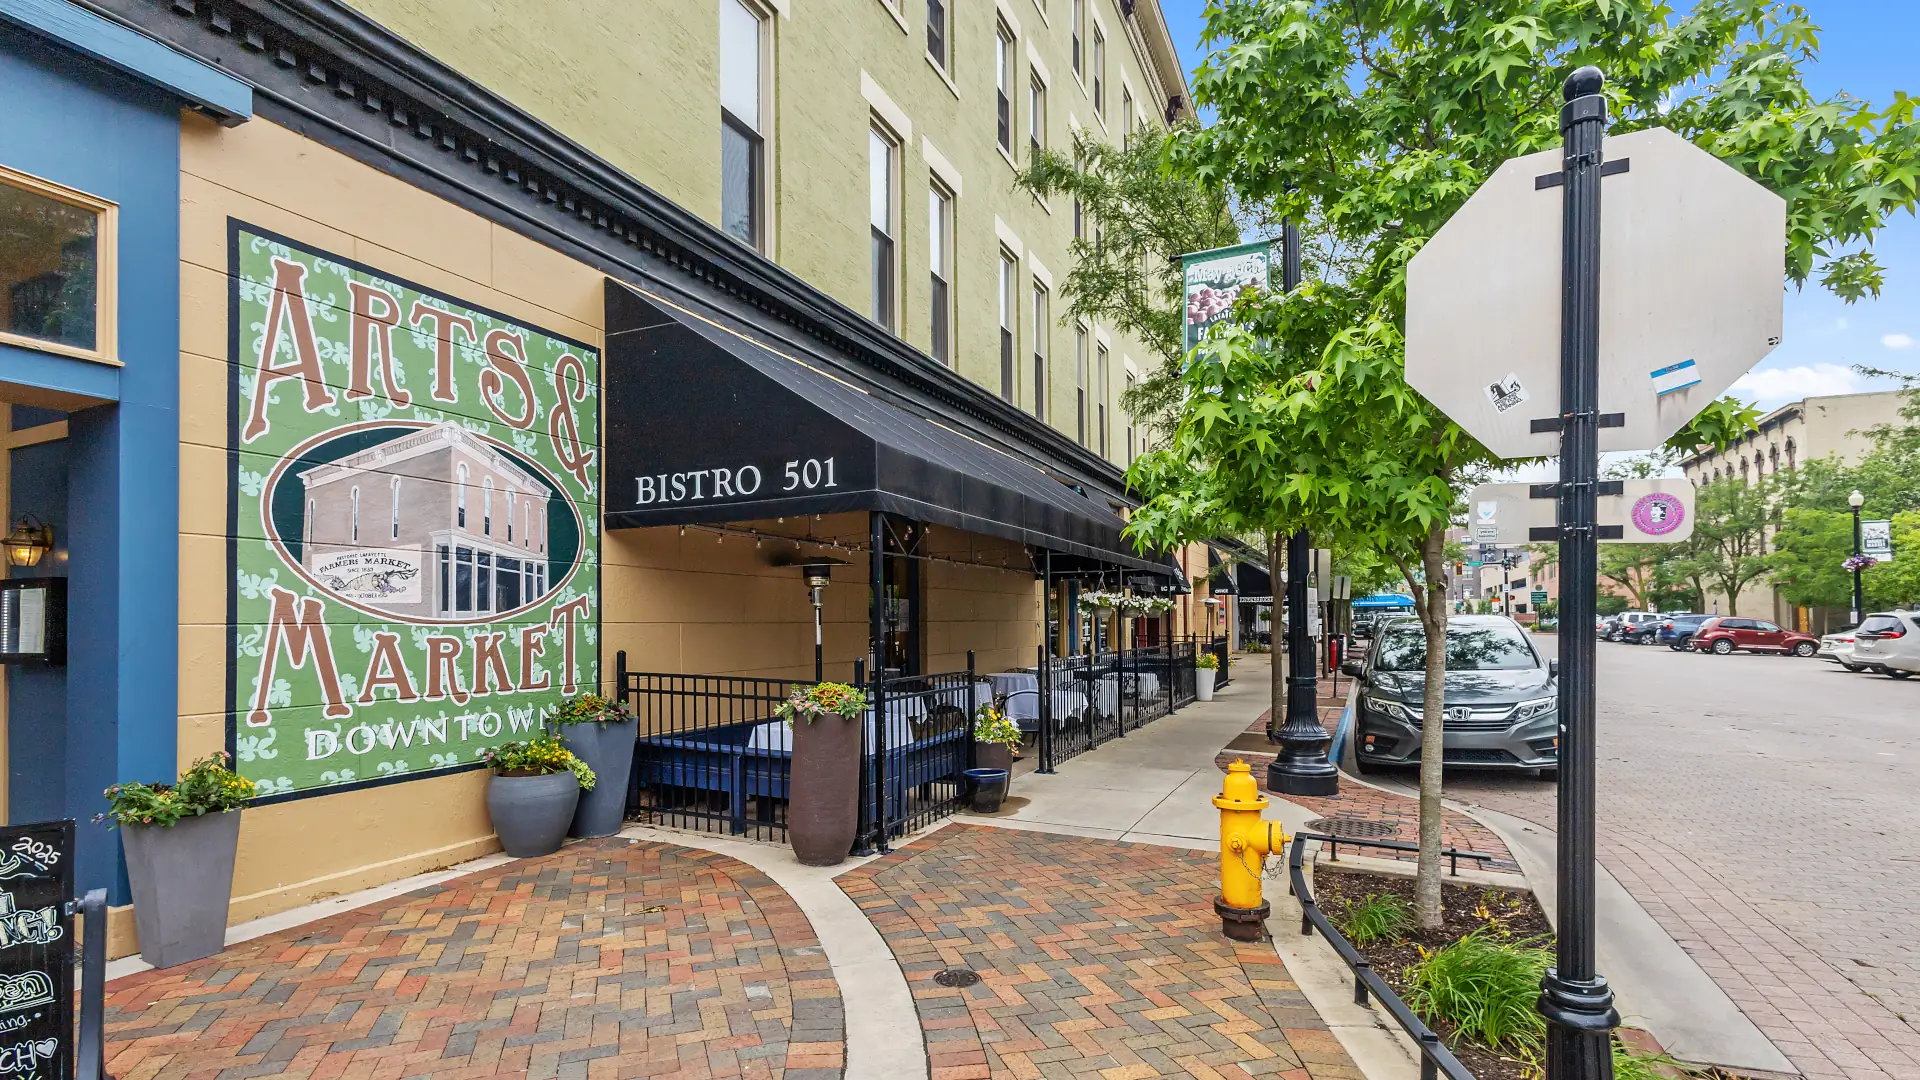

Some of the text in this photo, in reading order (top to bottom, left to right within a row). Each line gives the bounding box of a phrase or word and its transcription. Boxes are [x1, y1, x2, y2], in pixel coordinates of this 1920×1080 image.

[243, 255, 594, 495] ARTS &
[635, 456, 838, 505] BISTRO 501
[364, 557, 411, 570] MARKET
[247, 584, 590, 727] MARKET
[305, 703, 559, 761] DOWNTOWN
